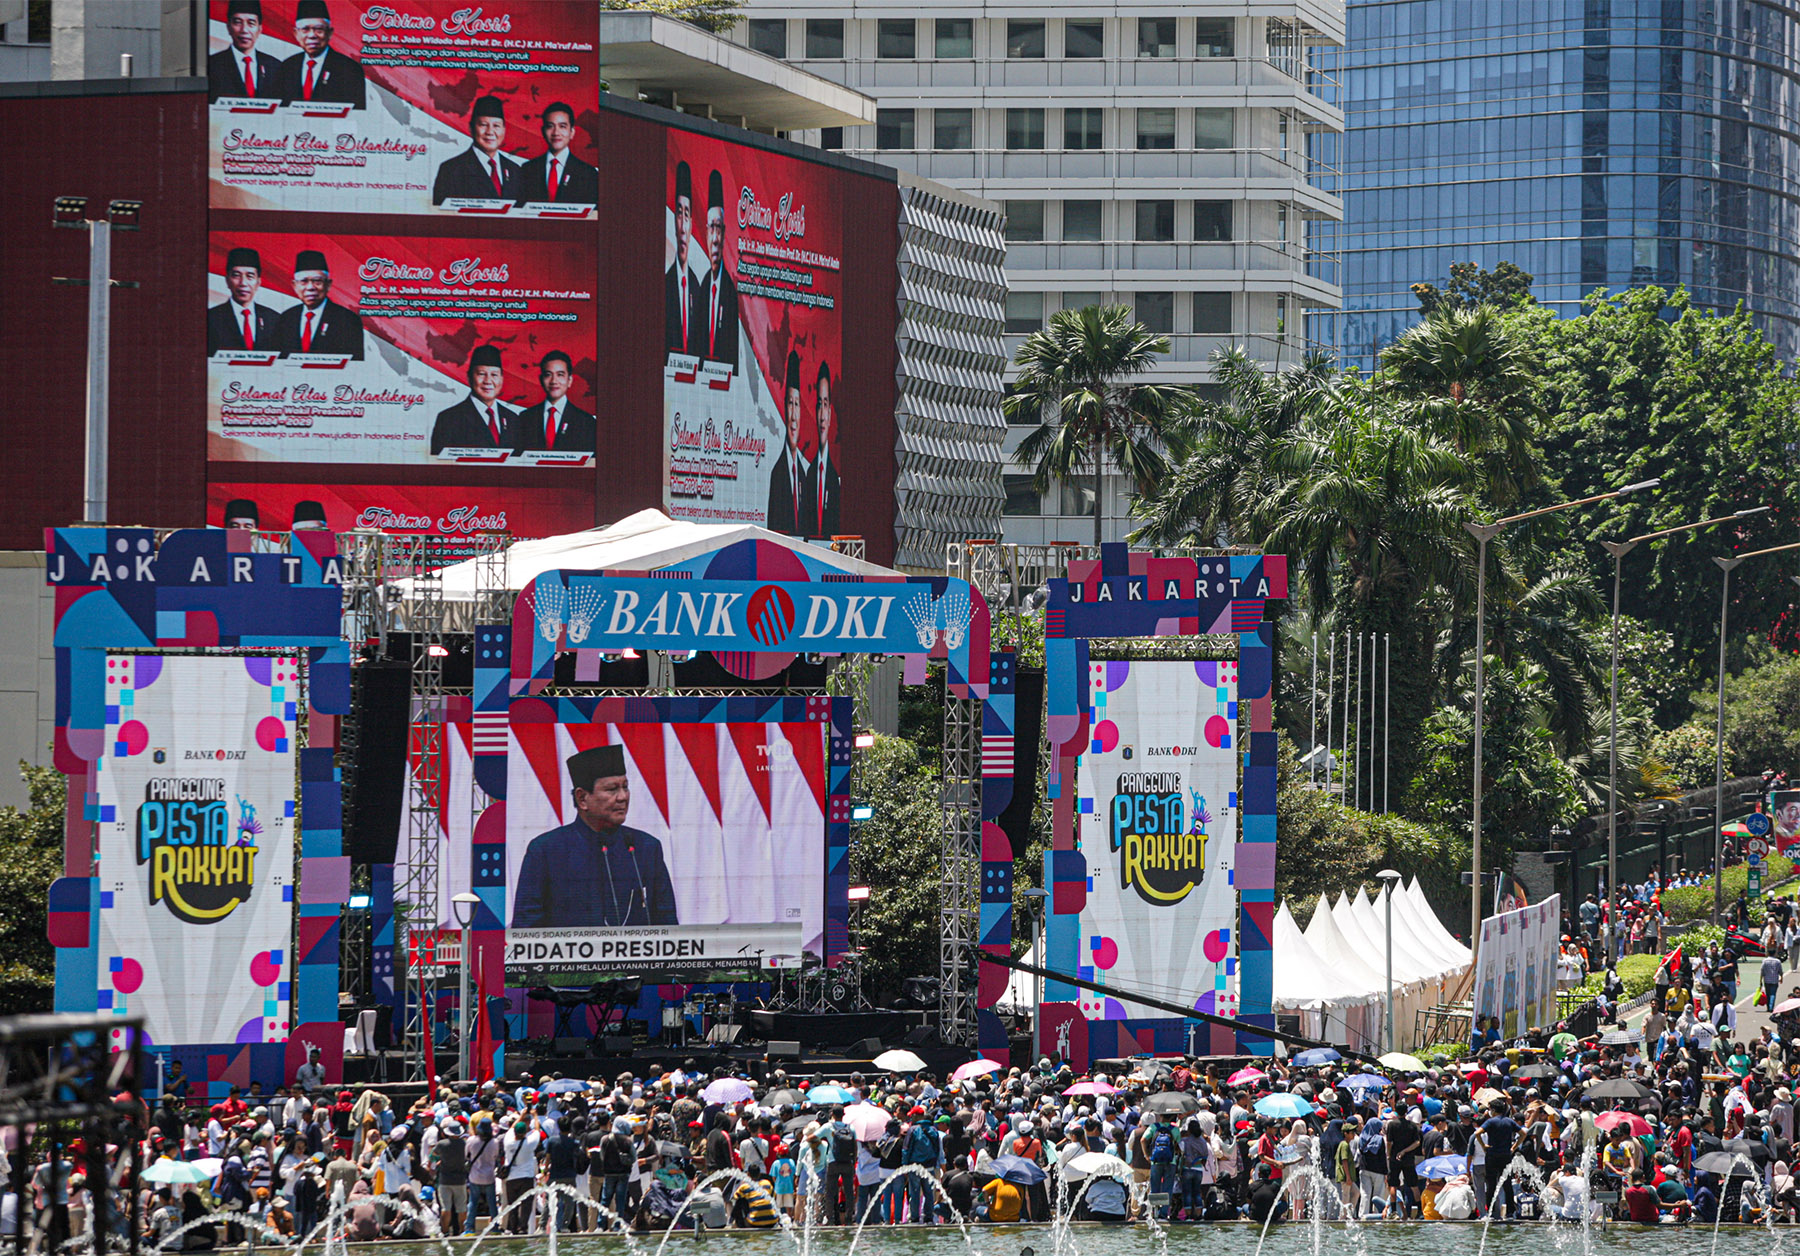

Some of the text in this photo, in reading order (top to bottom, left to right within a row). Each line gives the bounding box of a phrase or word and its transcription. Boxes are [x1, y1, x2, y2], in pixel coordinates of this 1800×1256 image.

[360, 6, 512, 36] Terima Kasih
[361, 46, 530, 60] Atas segala upaya dan dedikasinya untuk
[401, 35, 421, 43] Joko
[422, 36, 453, 44] Widodo
[454, 37, 470, 45] dan
[572, 42, 593, 50] Amin
[361, 58, 580, 73] memimpin dan membawa kemajuan bangsa Indonesia
[223, 128, 427, 161] Selamat Atas Dilantiknya
[223, 163, 252, 174] Tahun
[253, 164, 280, 175] 2024
[265, 154, 284, 164] dan
[224, 177, 257, 185] Selamat
[366, 182, 404, 190] Indonesia
[405, 182, 427, 190] Emas
[737, 186, 805, 241] Terima Kasih
[358, 256, 509, 286] Terima Kasih
[400, 286, 420, 294] Joko
[421, 287, 451, 295] Widodo
[569, 291, 590, 299] Amin
[381, 298, 408, 308] segala
[409, 300, 436, 308] upaya
[437, 299, 454, 307] dan
[455, 300, 503, 310] dedikasinya
[360, 309, 577, 322] memimpin dan membawa kemajuan bangsa Indonesia
[221, 381, 425, 411] Selamat Atas Dilantiknya
[264, 405, 282, 416] dan
[221, 415, 251, 426] Tahun
[251, 416, 278, 427] 2024
[286, 416, 314, 428] 2029
[222, 429, 256, 437] Selamat
[364, 432, 401, 440] Indonesia
[670, 412, 766, 468] Selamat Atas Dilantiknya
[356, 505, 507, 534] Terima Kasih
[50, 555, 343, 585] JAKARTA
[1071, 578, 1270, 603] JAKARTA
[604, 590, 896, 640] BANK DKI
[184, 750, 246, 760] BANK DKI
[1148, 747, 1198, 756] BANK DKI
[150, 778, 225, 801] PANGGUNG
[1121, 772, 1182, 793] PANGGUNG
[141, 801, 229, 860] PESTA
[1114, 793, 1184, 847] PESTA
[1125, 834, 1209, 901] RAKYAT
[154, 845, 259, 919] RAKYAT
[512, 931, 540, 939] RUANG
[574, 930, 618, 938] PARIPURNA
[624, 929, 659, 937] MPR/DPR
[514, 939, 704, 960] PIDATO PRESIDEN
[611, 962, 649, 970] LAYANAN
